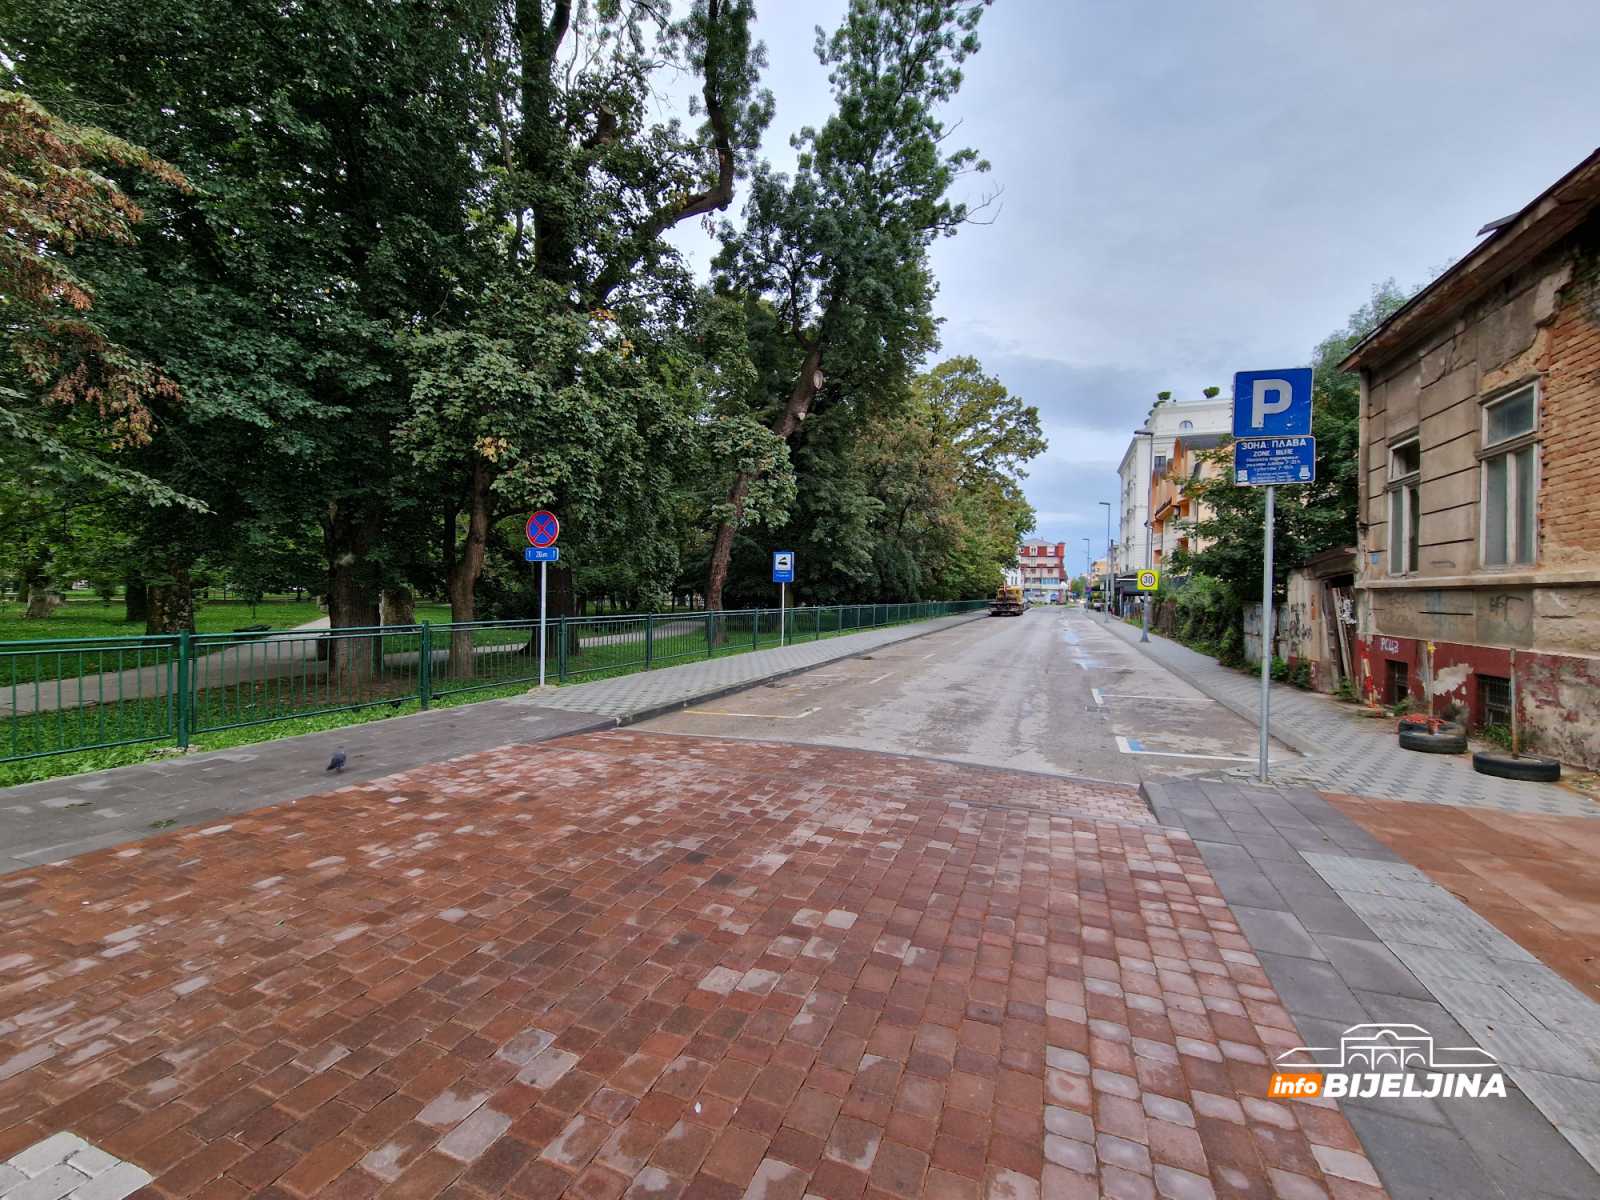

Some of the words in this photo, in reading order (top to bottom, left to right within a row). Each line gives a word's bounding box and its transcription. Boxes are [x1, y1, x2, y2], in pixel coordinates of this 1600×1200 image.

[1251, 379, 1293, 428] P
[1271, 438, 1307, 448] ПЛАВА
[1143, 575, 1153, 585] 30
